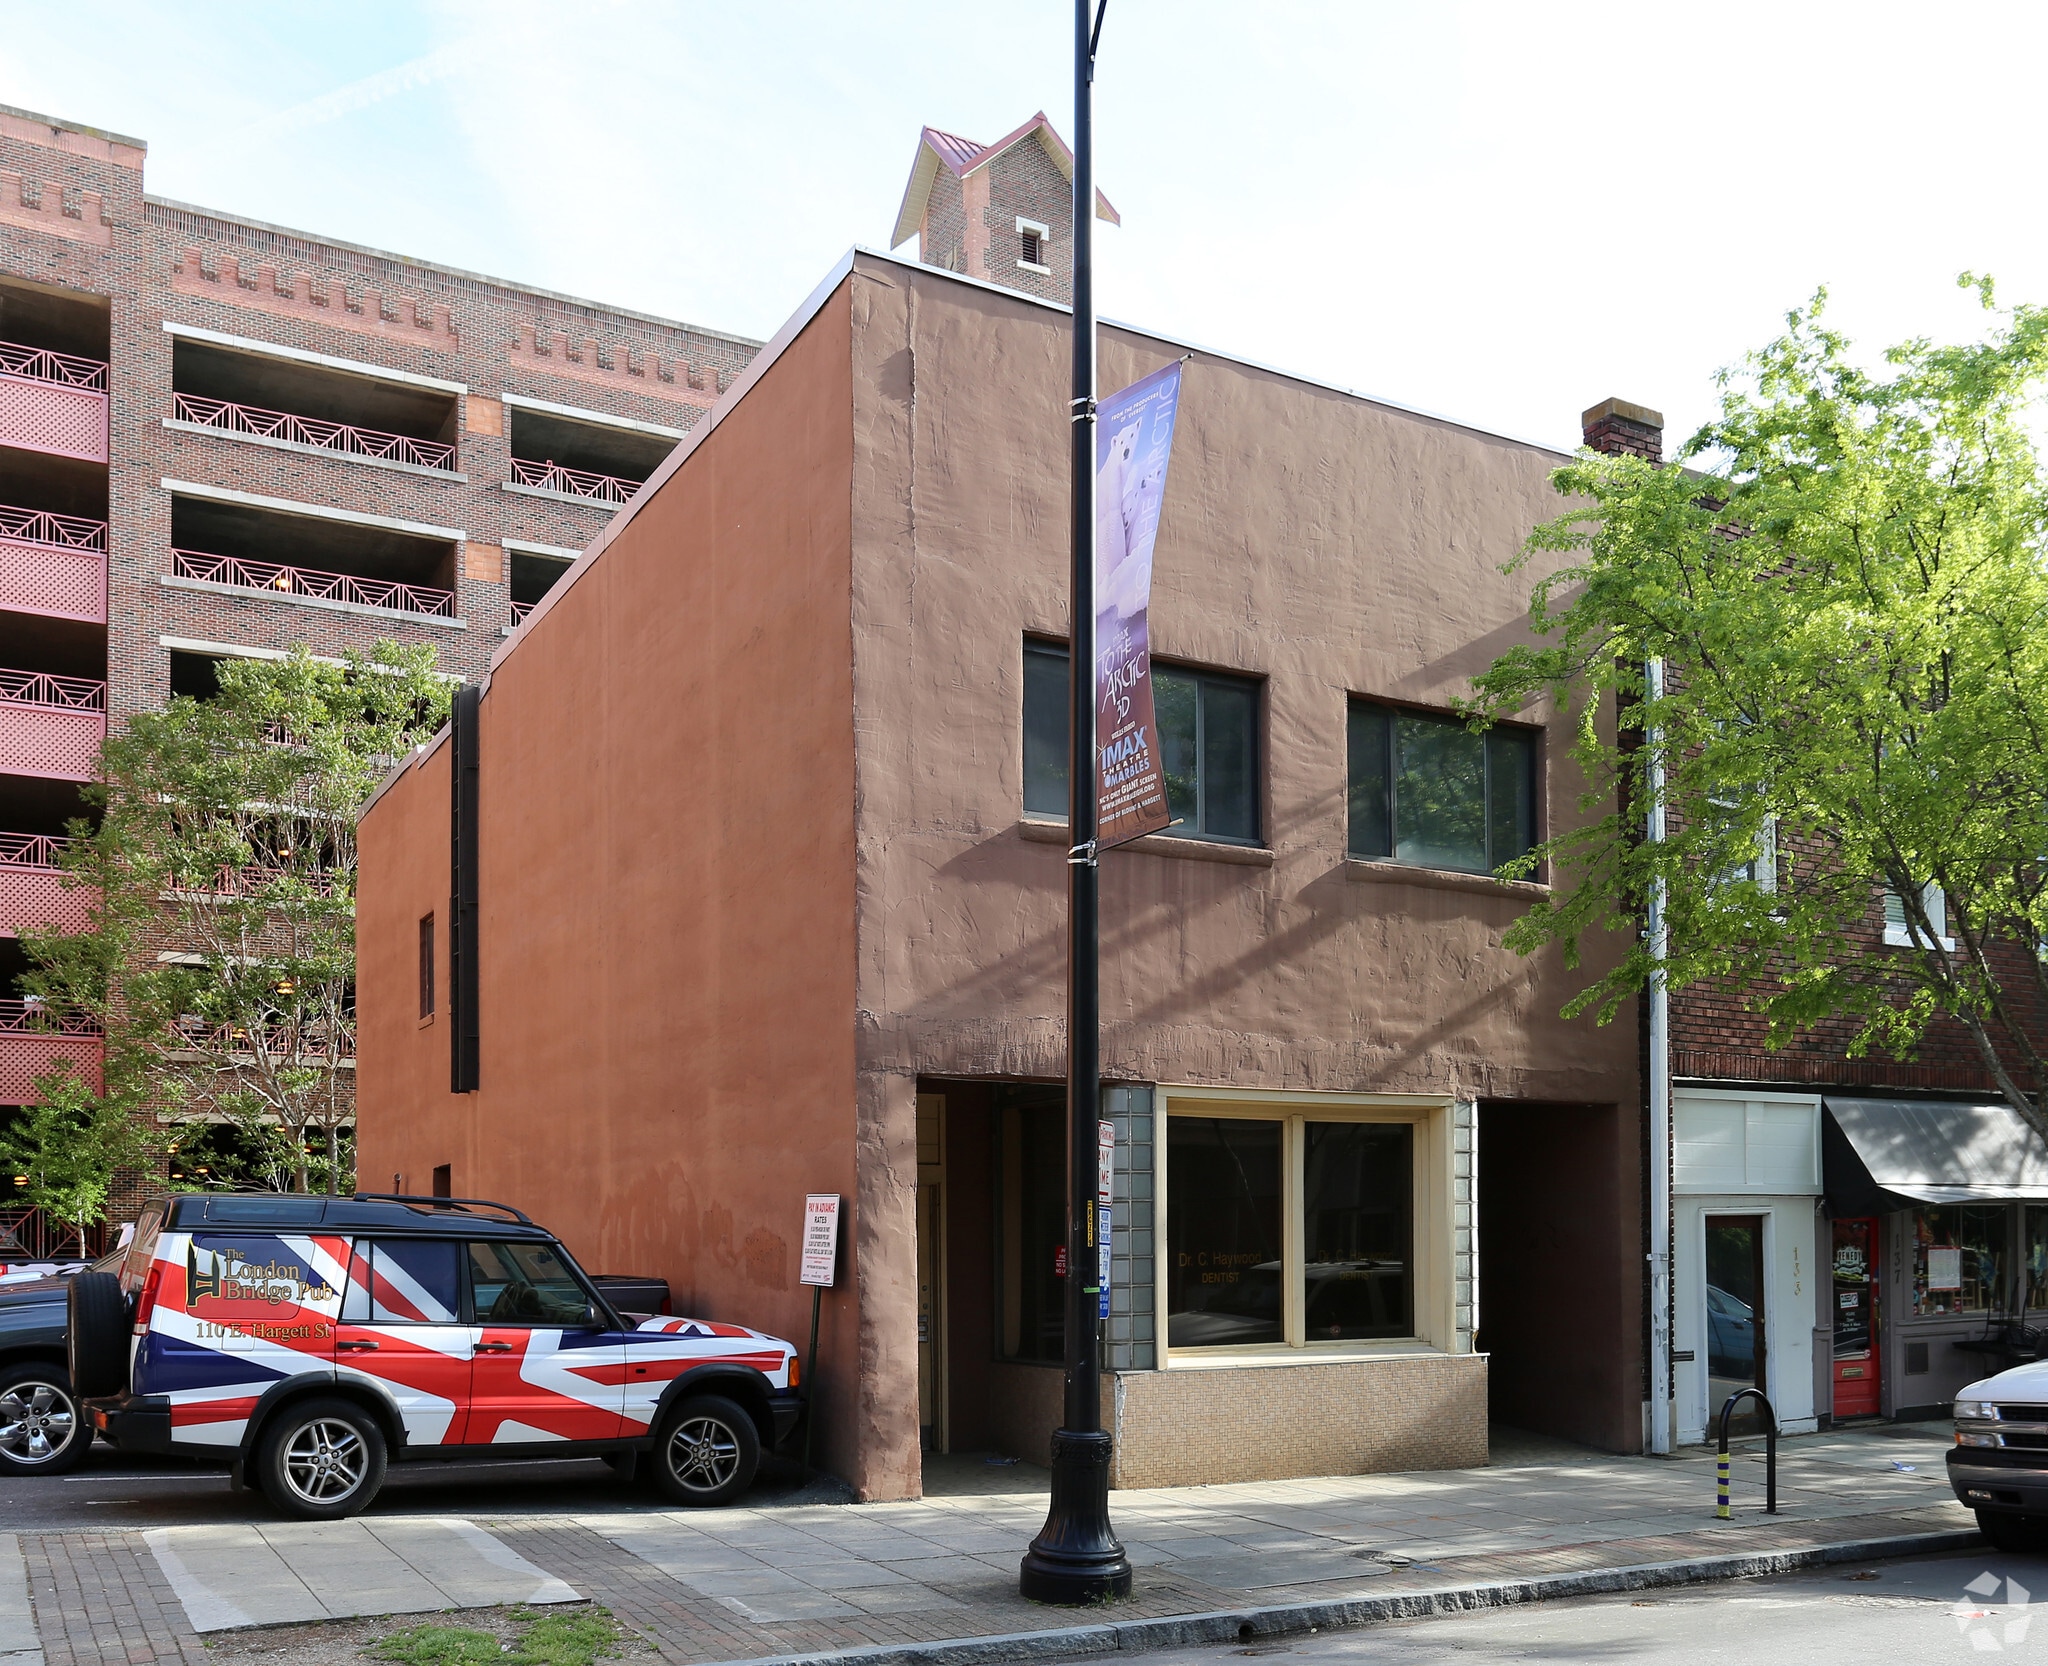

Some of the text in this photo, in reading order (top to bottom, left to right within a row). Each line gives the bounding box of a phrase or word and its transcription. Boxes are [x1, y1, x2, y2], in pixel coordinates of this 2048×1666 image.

[1112, 411, 1124, 421] FROM
[1133, 392, 1159, 409] PRODUCERS
[1147, 376, 1177, 485] ARCTIC
[1097, 636, 1132, 684] TO THE
[1101, 651, 1147, 714] ARCTIC
[1116, 696, 1130, 724] 3D
[1101, 726, 1147, 770] IMAX
[1102, 749, 1149, 777] THEATRE
[1099, 773, 1157, 805] NC'S ONLY GIANT SCREEN
[1099, 813, 1115, 825] CORNER
[1141, 794, 1161, 807] HARGETT
[814, 1216, 828, 1224] RATES
[225, 1248, 245, 1260] The
[1178, 1250, 1263, 1269] Dr. C. Haywood
[1838, 1250, 1862, 1261] REMEDY
[224, 1260, 300, 1280] London
[1201, 1271, 1241, 1284] DENTIST
[224, 1280, 333, 1305] Bridge Pub
[196, 1322, 330, 1342] 110 E. Hargett St
